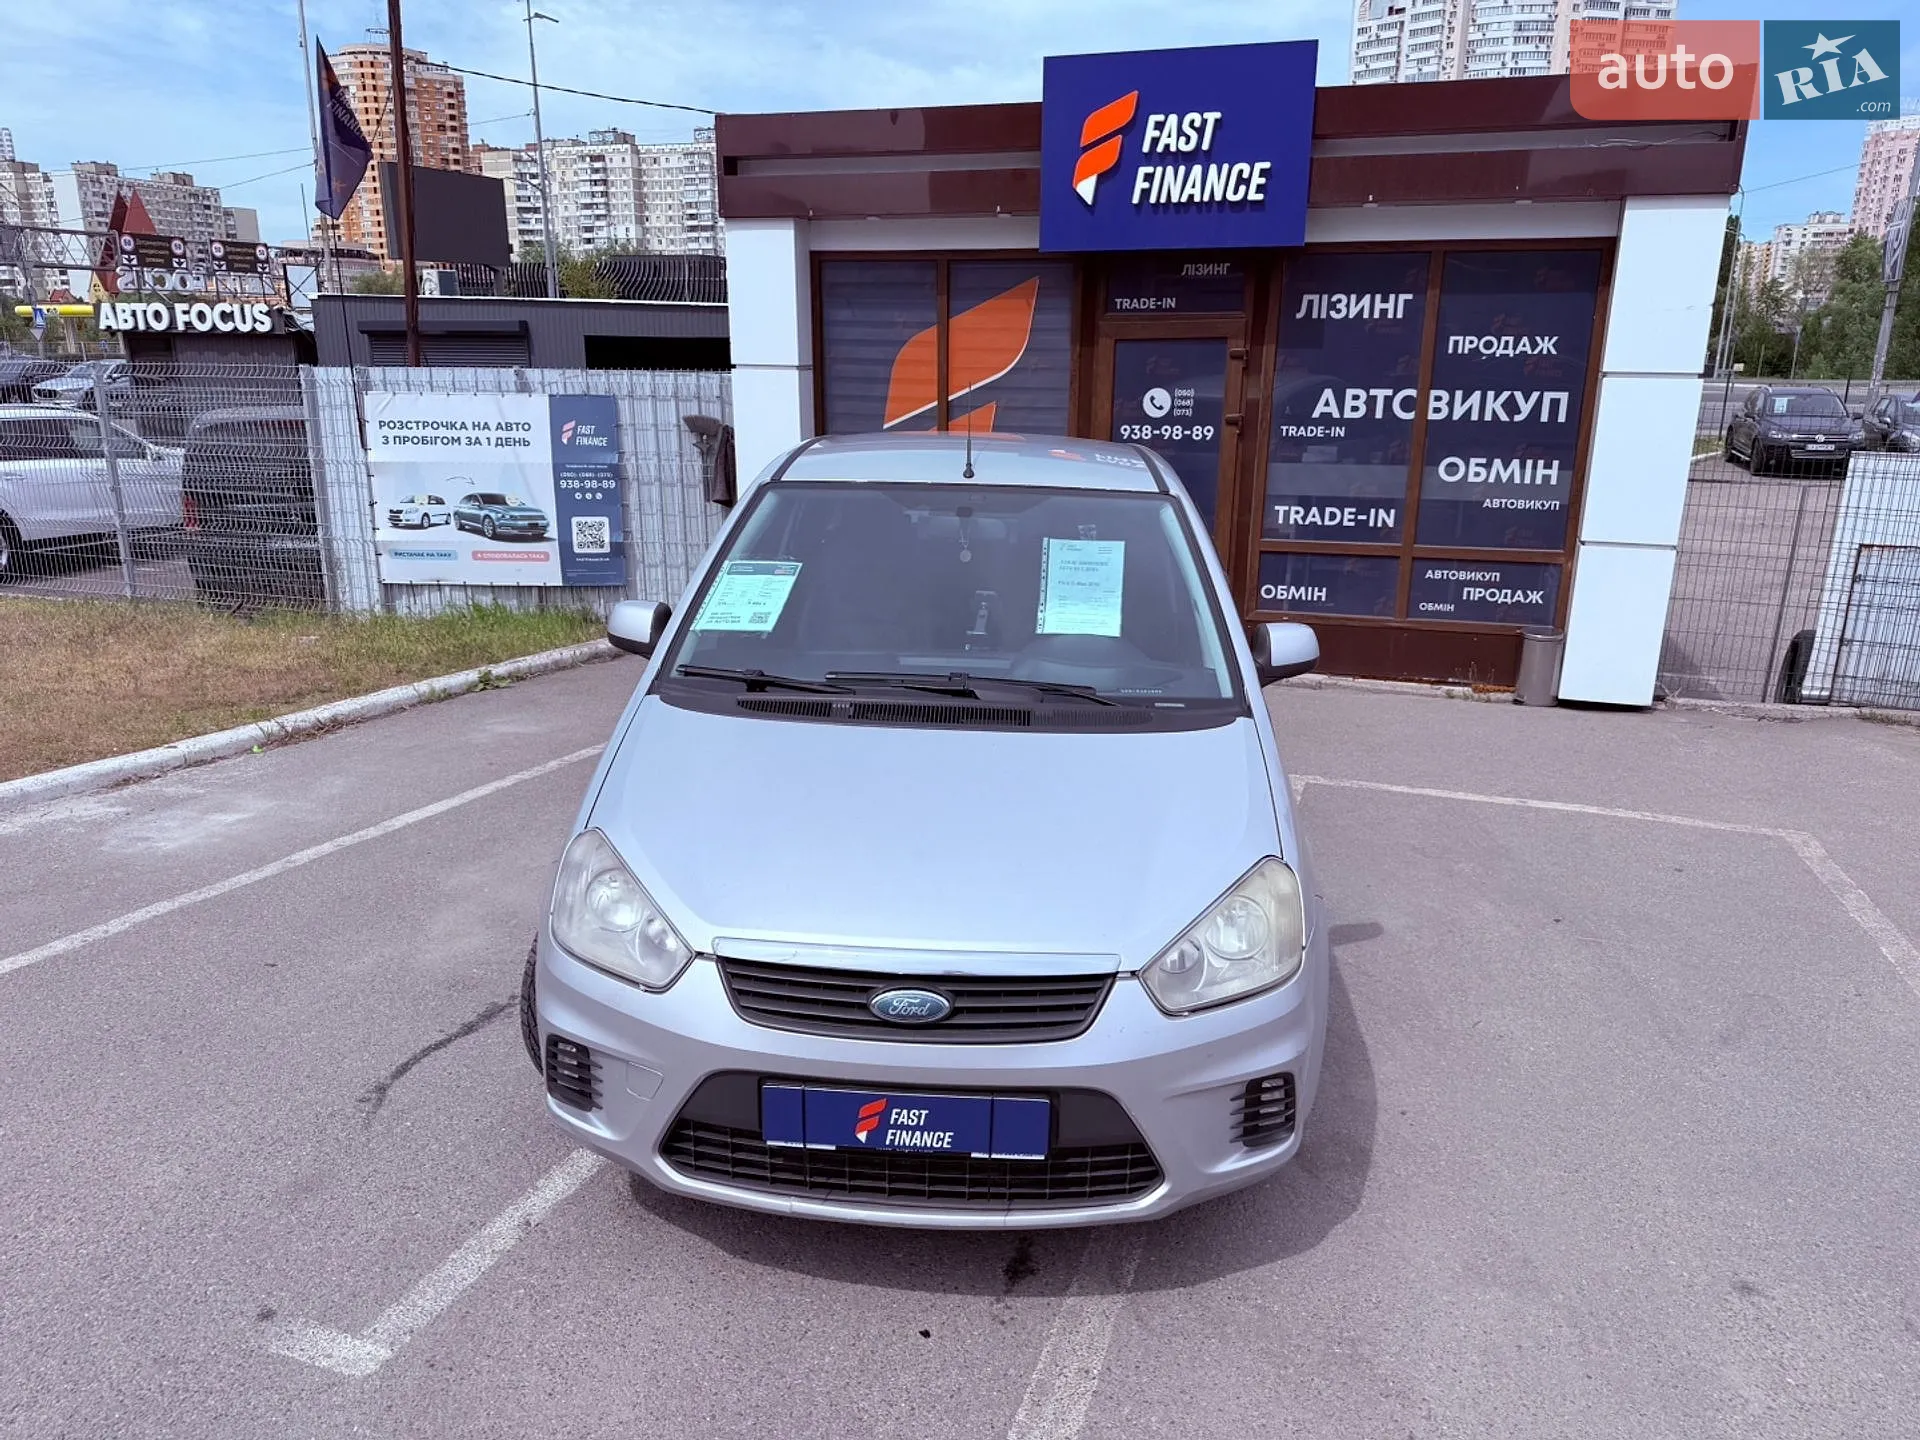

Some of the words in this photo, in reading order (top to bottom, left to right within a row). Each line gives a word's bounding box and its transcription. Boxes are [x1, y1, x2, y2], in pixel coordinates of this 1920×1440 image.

[1142, 111, 1222, 153] FAST
[1132, 161, 1271, 205] FINANCE
[1181, 263, 1231, 276] ЛІЗИНГ
[1115, 298, 1176, 310] TRADE-IN
[1296, 293, 1413, 319] ЛІЗИНГ
[174, 303, 273, 332] FOCUS
[1448, 335, 1558, 357] ПРОДАЖ
[378, 420, 468, 431] РОЗСТРОЧКА
[472, 421, 491, 431] НА
[495, 422, 531, 432] АВТО
[577, 425, 596, 435] FAST
[1120, 425, 1214, 440] 938-98-89
[1280, 425, 1345, 438] TRADE-IN
[393, 435, 461, 446] ПРОБІГОМ
[465, 436, 482, 446] ЗА
[486, 437, 491, 446] 1
[494, 437, 531, 448] ДЕНЬ
[575, 436, 608, 447] FINANCE
[1438, 456, 1560, 485] ОБМІН
[560, 480, 616, 489] 938-98-89
[1482, 498, 1560, 511] АВТОВИКУП
[1274, 505, 1396, 528] TRADE-IN
[1425, 569, 1500, 582] АВТОВИКУП
[1260, 584, 1327, 601] ОБМІН
[1462, 587, 1544, 604] ПРОДАЖ
[1419, 602, 1455, 612] ОБМІН
[889, 997, 931, 1016] Ford
[890, 1108, 929, 1126] FAST
[886, 1129, 954, 1148] FINANCE
